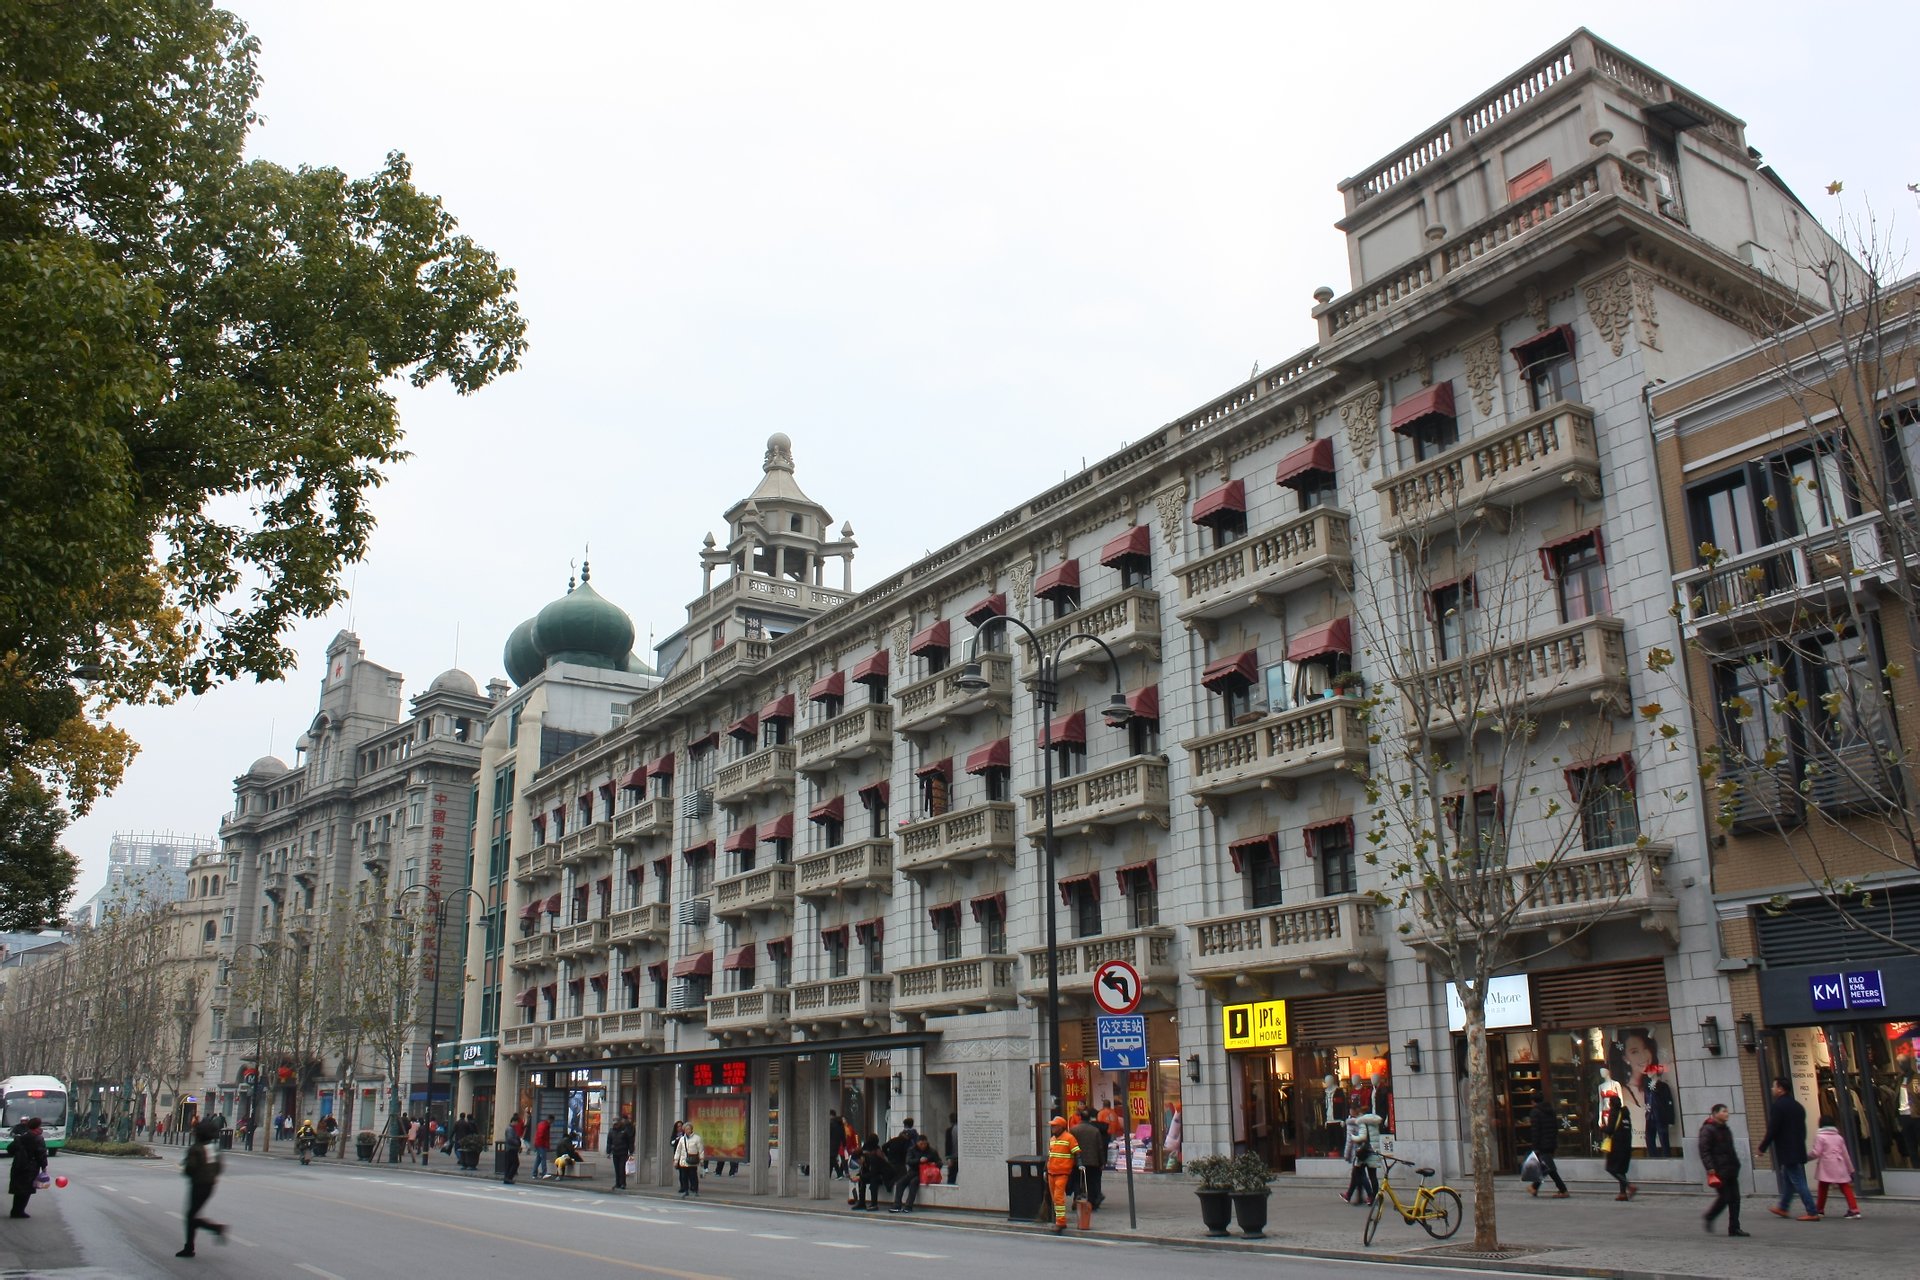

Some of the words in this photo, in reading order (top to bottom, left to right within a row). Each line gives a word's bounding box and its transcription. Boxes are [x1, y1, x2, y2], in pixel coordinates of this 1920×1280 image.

[1848, 976, 1865, 984] KILO
[1491, 991, 1521, 1005] Maore
[1813, 983, 1840, 1000] KM
[1850, 990, 1880, 998] METERS
[1235, 1013, 1243, 1035] J
[1259, 1007, 1274, 1029] JPT
[1275, 1017, 1282, 1026] &
[1100, 1020, 1142, 1034] 公交车站
[1259, 1030, 1283, 1041] HOME
[1133, 1097, 1145, 1116] 99
